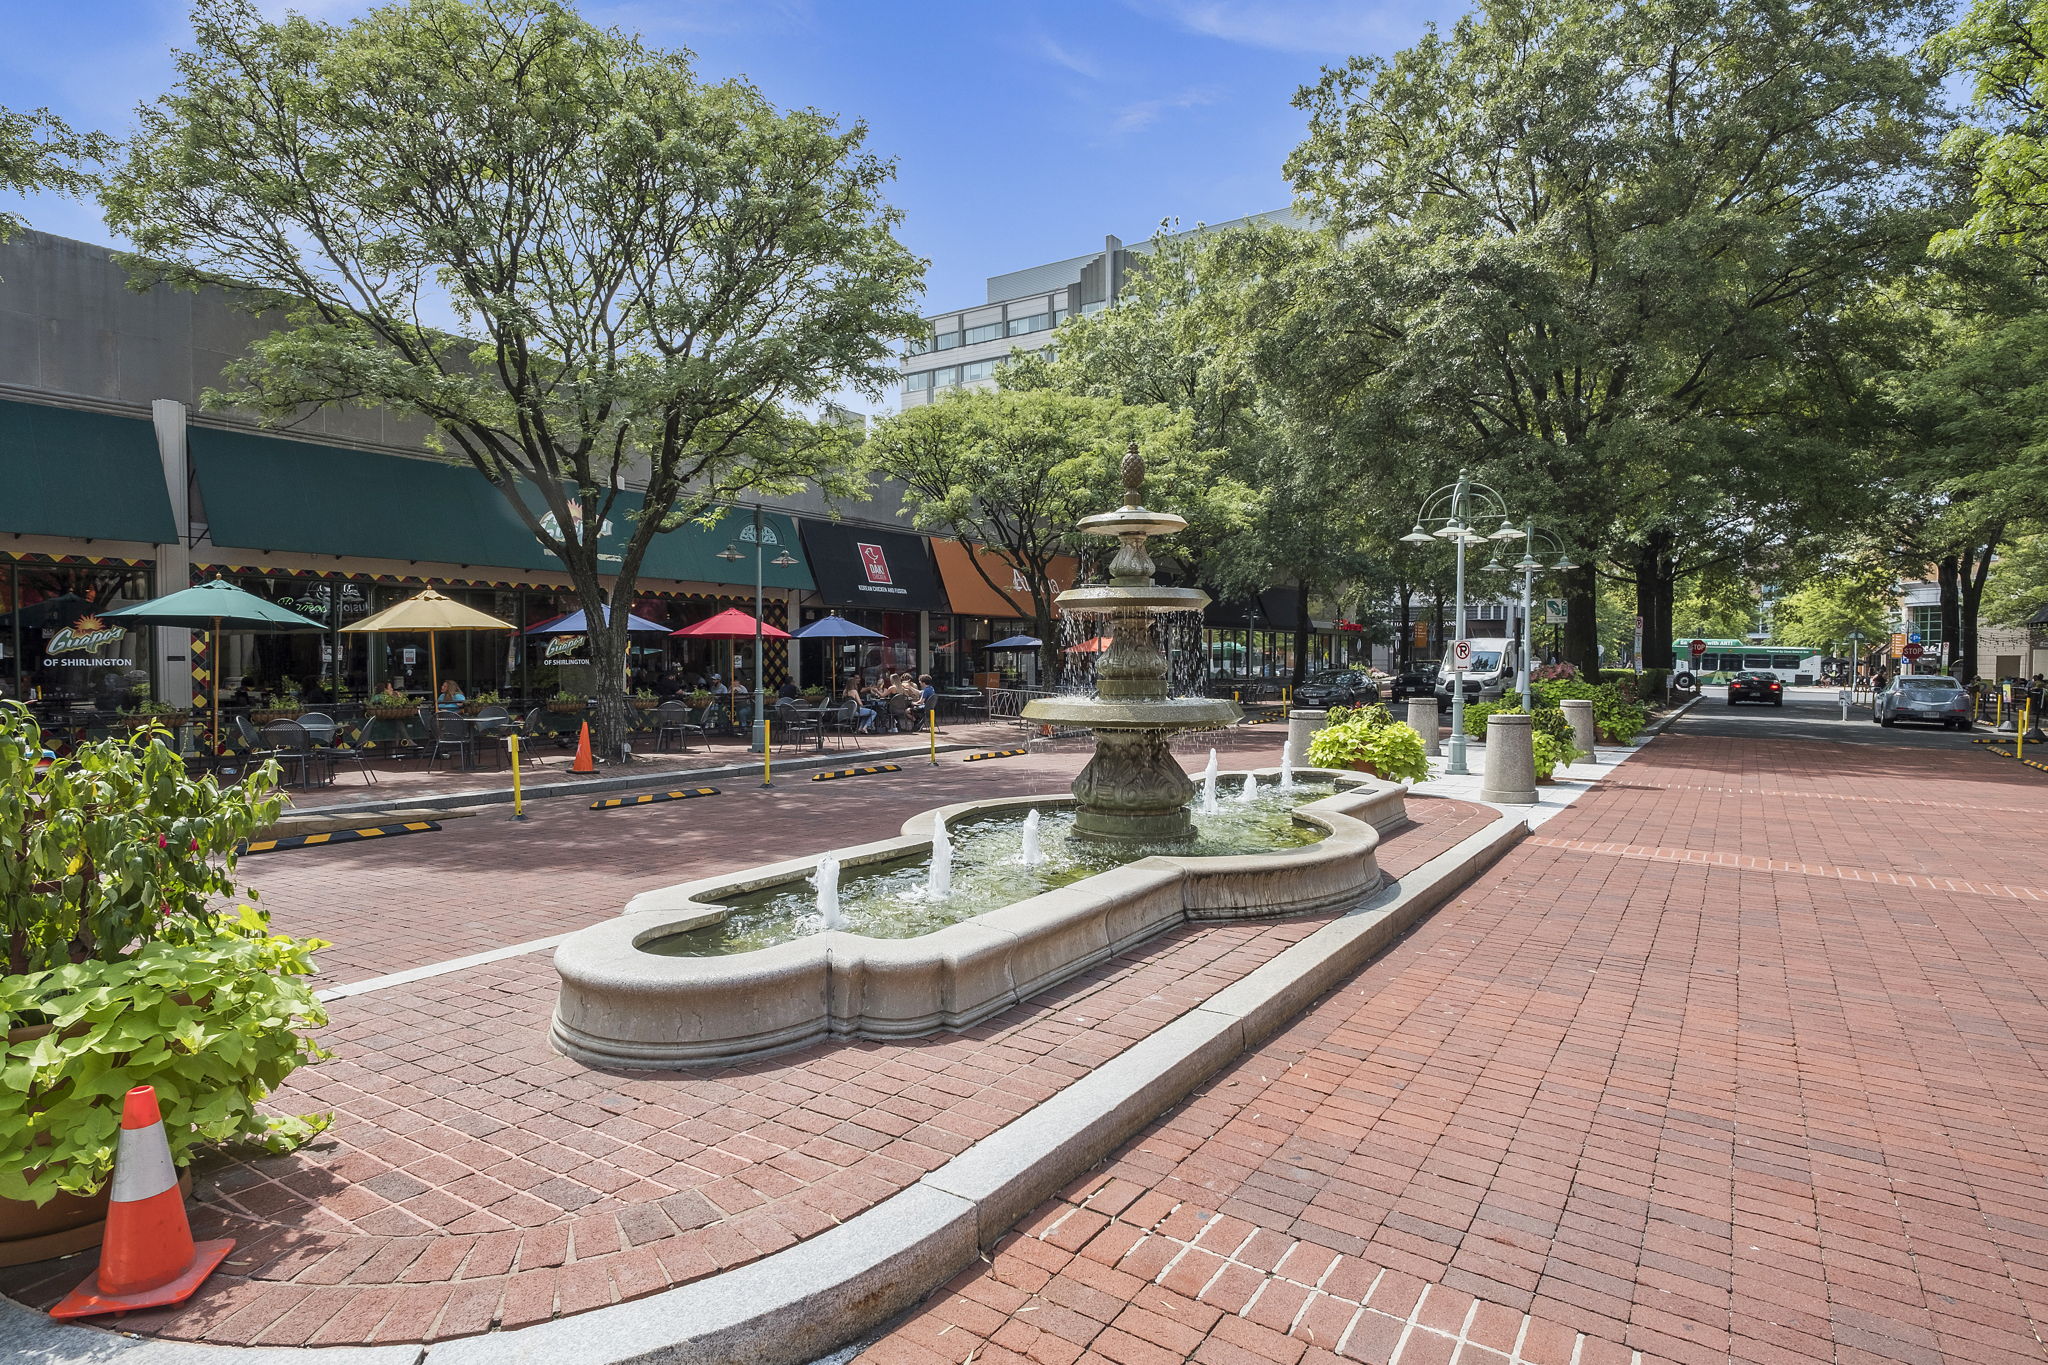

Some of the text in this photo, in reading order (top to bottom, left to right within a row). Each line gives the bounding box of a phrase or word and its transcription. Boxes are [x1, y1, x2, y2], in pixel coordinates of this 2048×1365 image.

[47, 626, 123, 654] Guapo's
[546, 636, 584, 656] Guapo's
[43, 658, 132, 667] OF SHIRLINGTON
[553, 658, 590, 666] SHIRLINGTON
